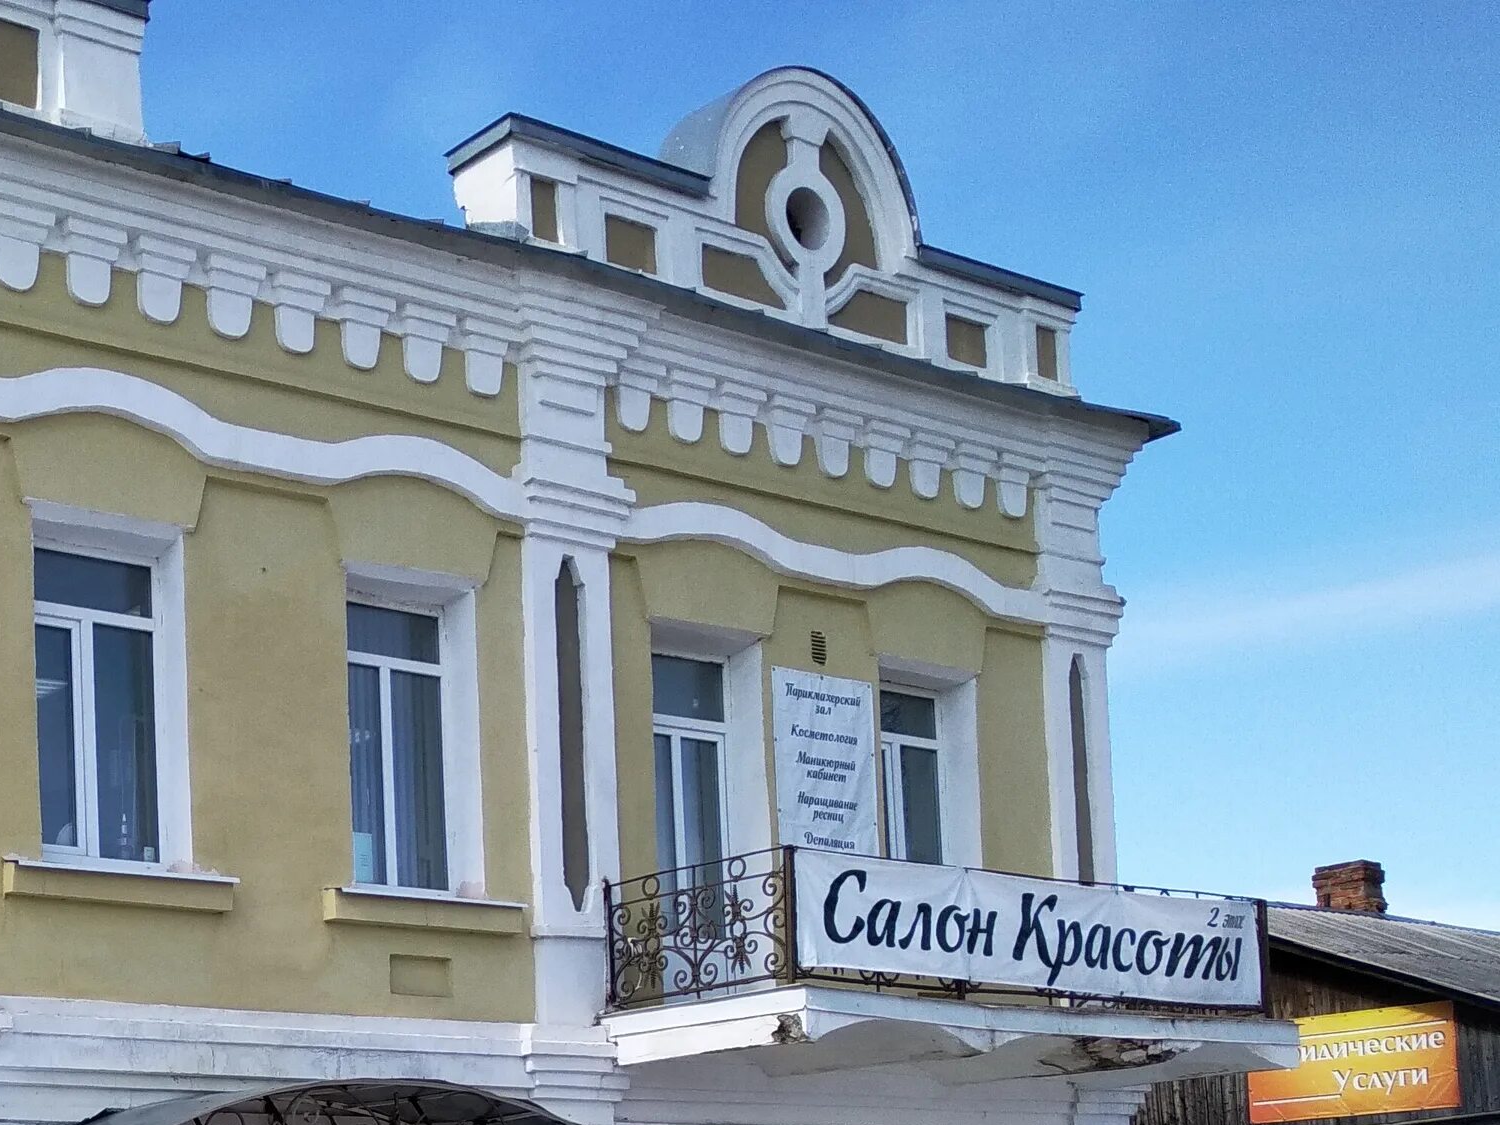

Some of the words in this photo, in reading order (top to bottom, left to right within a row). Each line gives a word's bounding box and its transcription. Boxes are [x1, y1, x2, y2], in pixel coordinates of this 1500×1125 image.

[785, 682, 861, 708] Парикмахерский
[815, 705, 831, 715] зал
[791, 724, 858, 746] Косметология
[796, 751, 856, 772] Маникюрный
[807, 768, 847, 783] кабинет
[797, 791, 858, 811] Наращивание
[812, 809, 844, 824] ресниц
[804, 832, 855, 850] Депиляция
[1207, 907, 1219, 927] 2
[823, 869, 998, 957] Салон
[1012, 892, 1243, 987] Красоты
[1298, 1030, 1445, 1062] идические
[1331, 1067, 1428, 1096] Услуги
